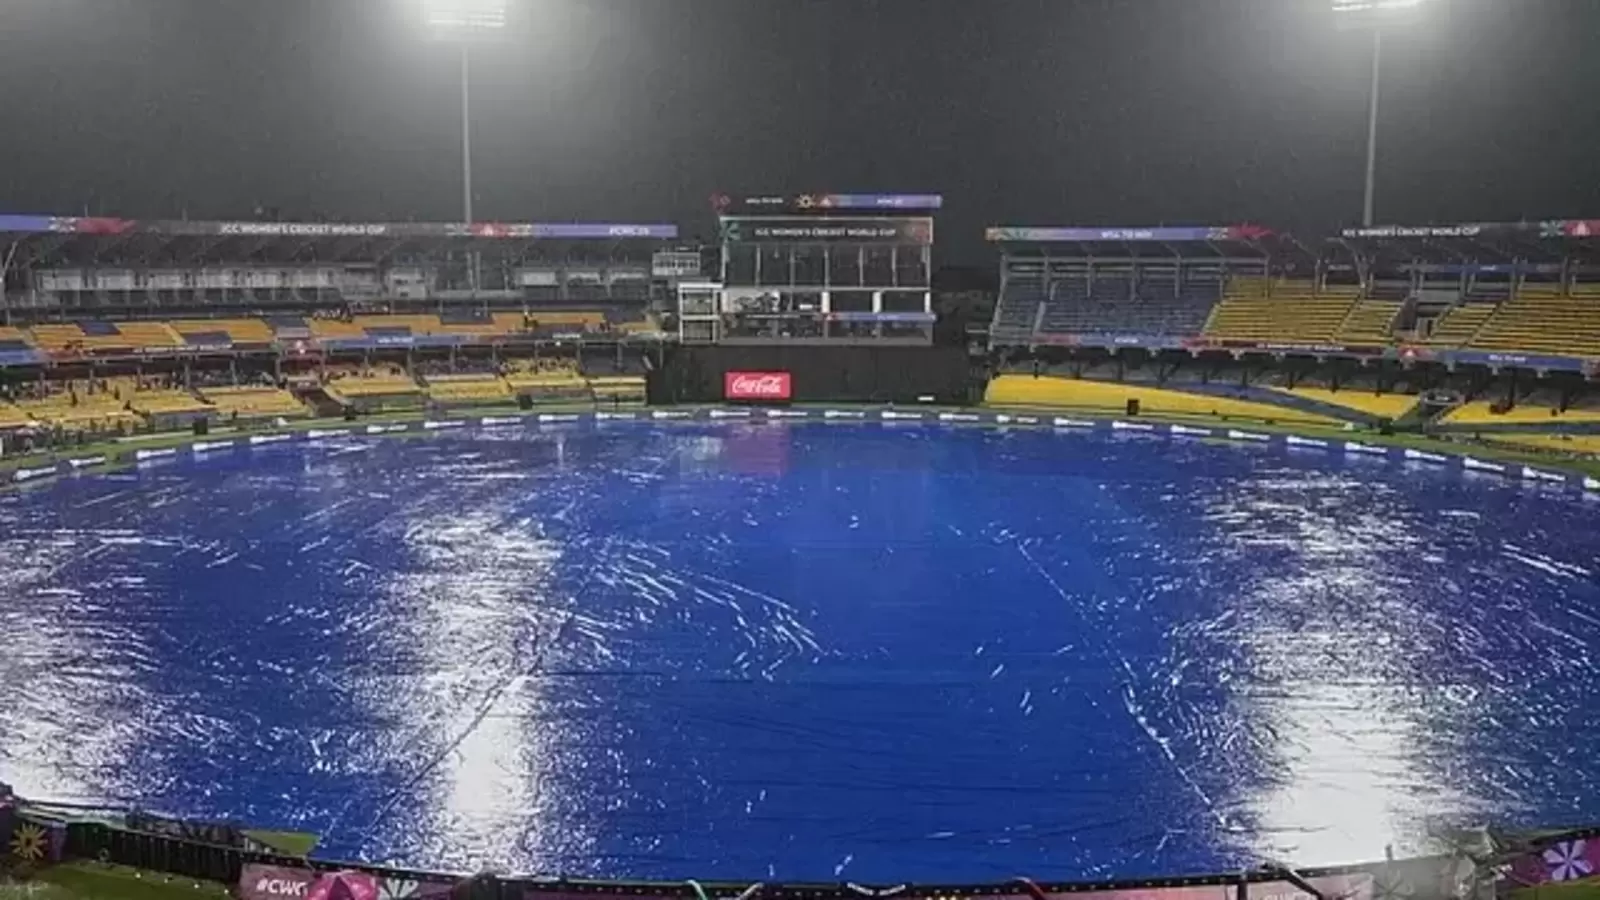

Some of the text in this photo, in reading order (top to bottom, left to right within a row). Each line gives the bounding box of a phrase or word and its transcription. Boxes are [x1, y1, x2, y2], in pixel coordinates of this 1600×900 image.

[289, 224, 329, 234] CRICKET
[332, 224, 365, 235] WORLD
[367, 224, 385, 234] CUP
[812, 227, 845, 237] CRICKET
[848, 228, 877, 237] WORLD
[1432, 226, 1460, 236] WORLD
[1462, 225, 1480, 236] CUP
[732, 376, 781, 394] Coca-Cola
